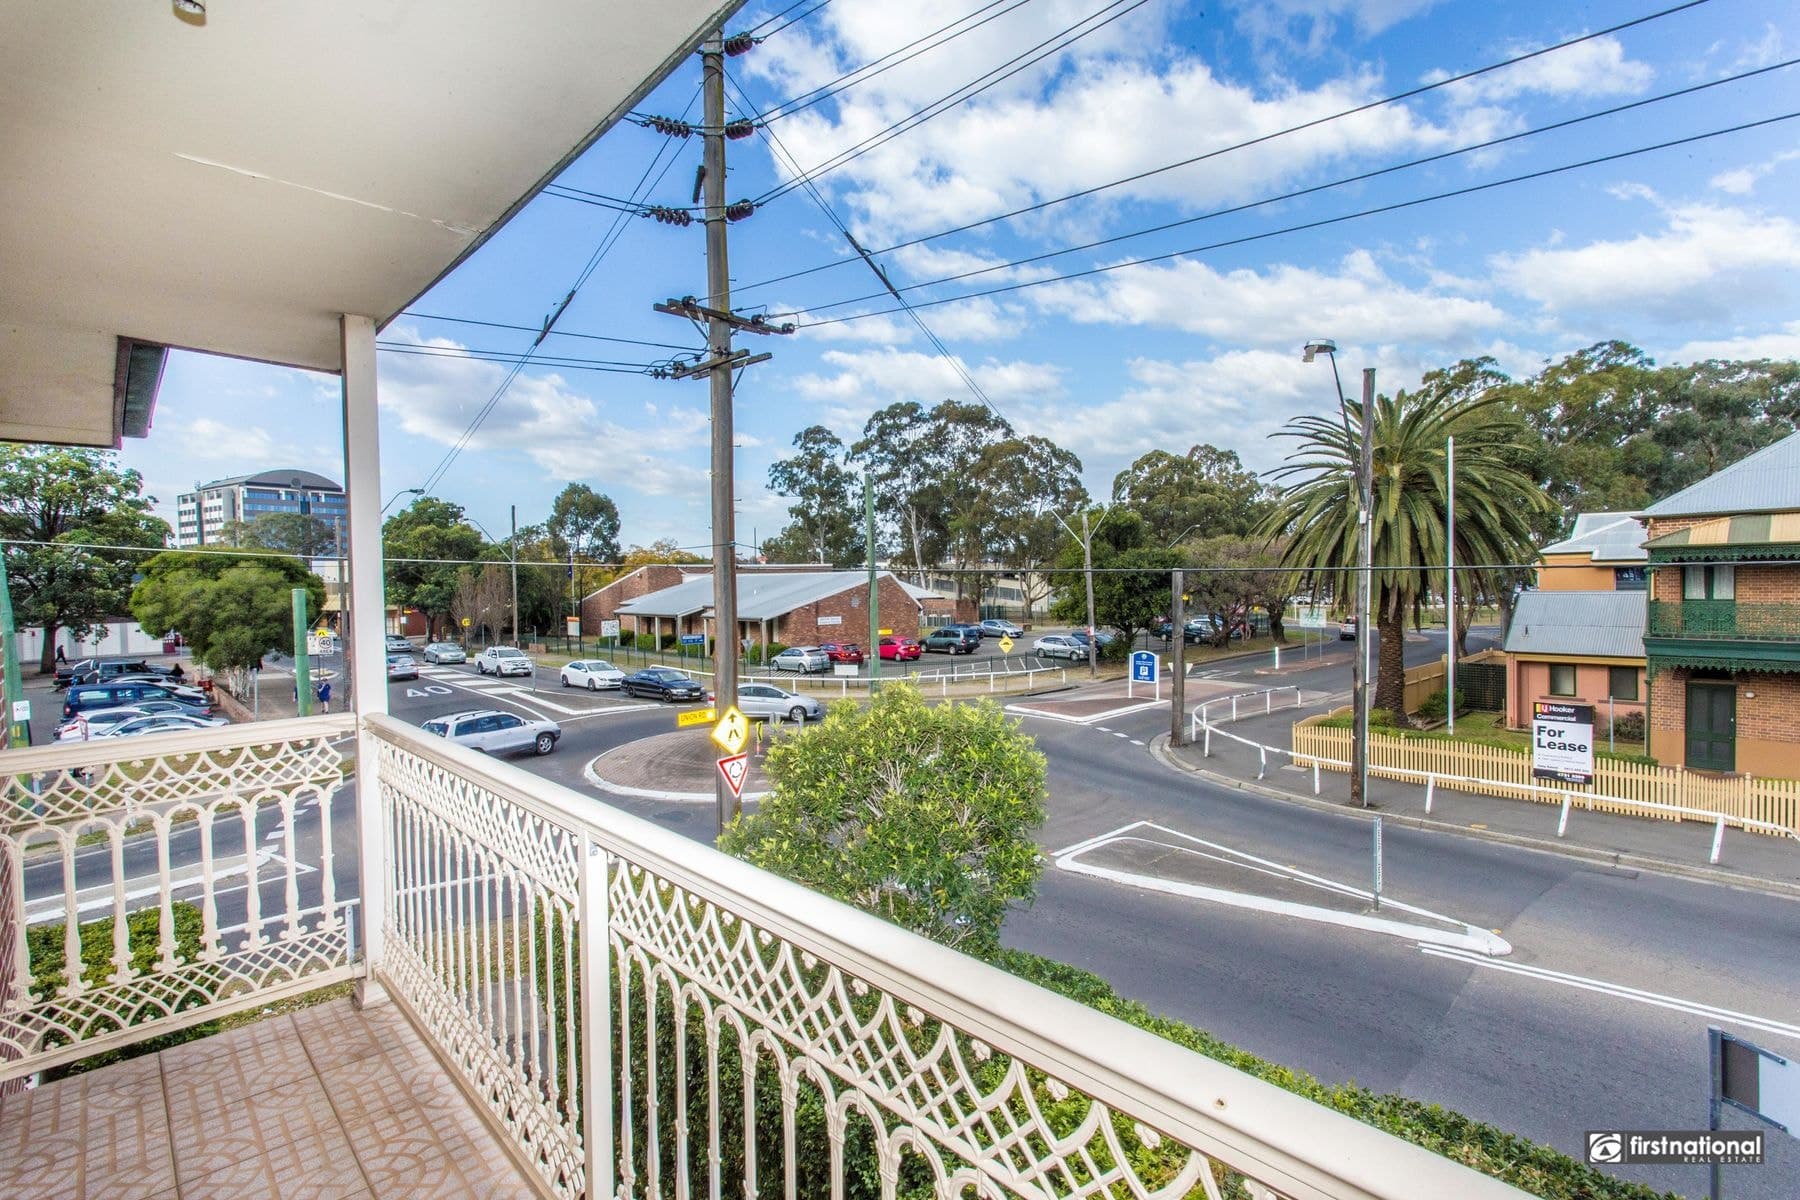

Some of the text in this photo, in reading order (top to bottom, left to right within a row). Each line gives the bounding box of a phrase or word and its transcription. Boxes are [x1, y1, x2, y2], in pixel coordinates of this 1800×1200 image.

[407, 685, 453, 698] 40
[1549, 705, 1575, 714] Hooker
[680, 711, 707, 722] UNION RD
[1536, 713, 1577, 722] Commercial
[1537, 725, 1565, 738] For
[1537, 737, 1588, 753] Lease
